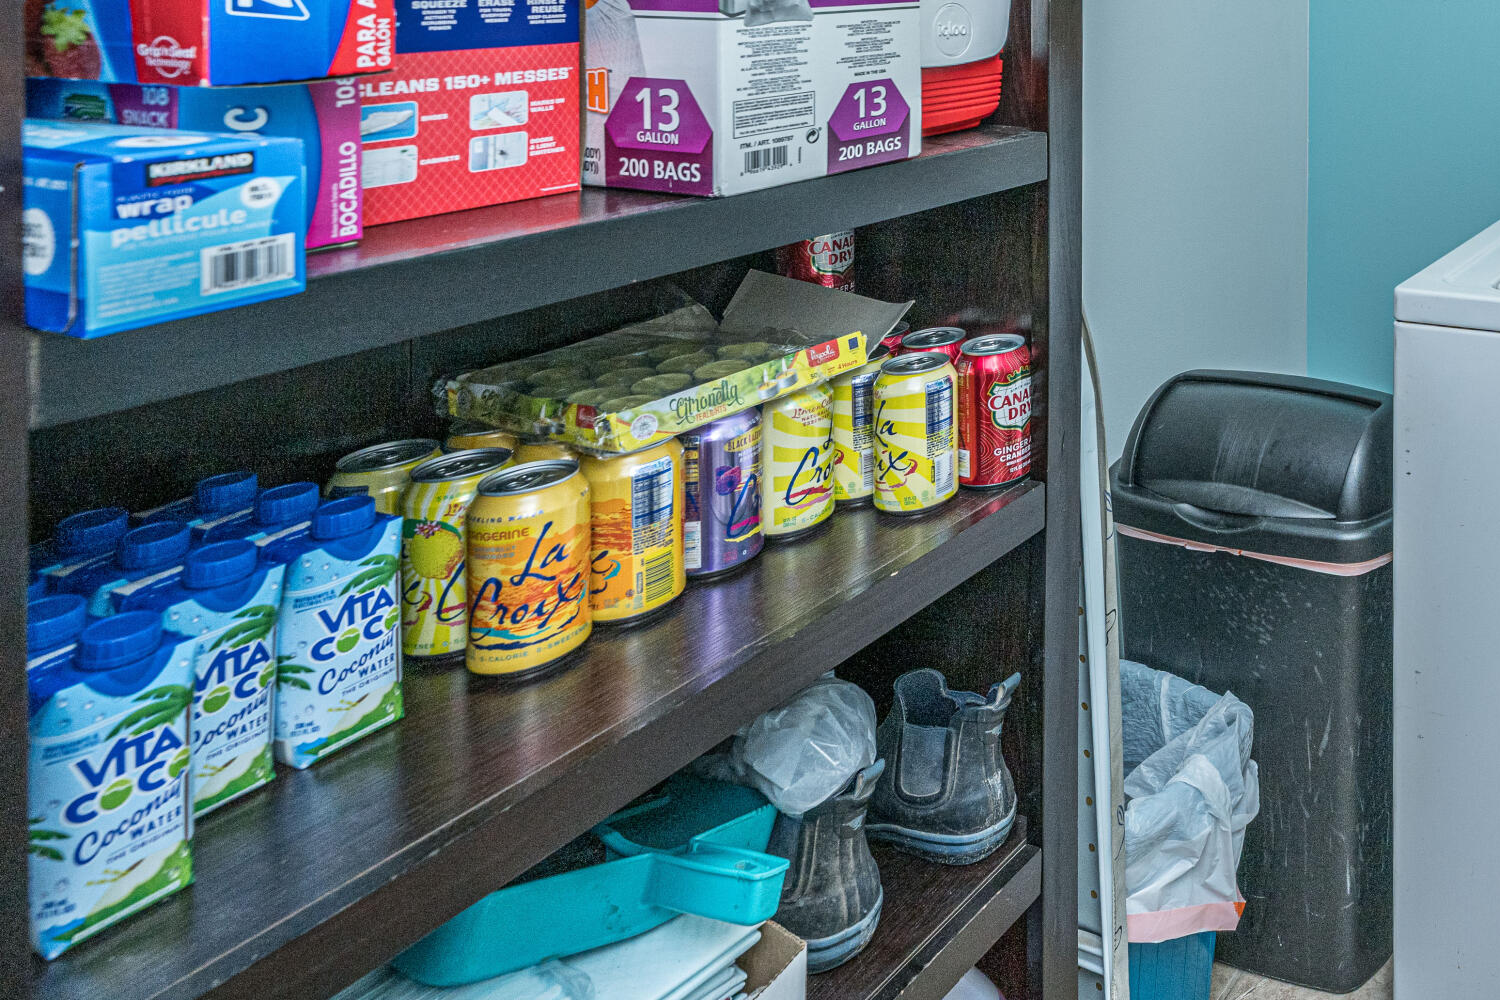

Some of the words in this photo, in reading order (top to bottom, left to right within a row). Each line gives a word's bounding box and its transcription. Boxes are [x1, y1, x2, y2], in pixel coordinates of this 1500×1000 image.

[411, 0, 468, 9] SQUEEZE
[531, 5, 565, 13] REUSE
[356, 13, 377, 68] PARA
[377, 17, 392, 67] GALÓN
[444, 74, 491, 91] 150+
[494, 66, 570, 86] MESSES
[142, 87, 169, 106] 108
[853, 85, 887, 118] 13
[122, 109, 169, 126] SNACK
[635, 88, 680, 132] 13
[853, 118, 887, 131] GALLON
[636, 131, 679, 145] GALLON
[838, 145, 863, 162] 200
[866, 136, 902, 156] BAGS
[149, 152, 254, 178] KIRKLAND
[619, 157, 649, 178] 200
[653, 160, 701, 182] BAGS
[339, 141, 357, 237] BOCADILLO
[116, 194, 194, 220] wrap
[111, 208, 247, 248] pellicule
[809, 234, 854, 255] CANAD
[669, 379, 745, 426] Citronella
[695, 404, 727, 422] TEALIGHTS
[988, 390, 1031, 411] CANA
[727, 436, 748, 451] BLACK
[993, 438, 1028, 456] GINGER
[786, 447, 834, 506] Cro
[510, 521, 570, 586] La
[318, 586, 395, 634] VITA
[469, 573, 581, 642] Croix
[318, 623, 397, 695] Coconut
[358, 653, 395, 678] WATER
[76, 725, 183, 788] VITA
